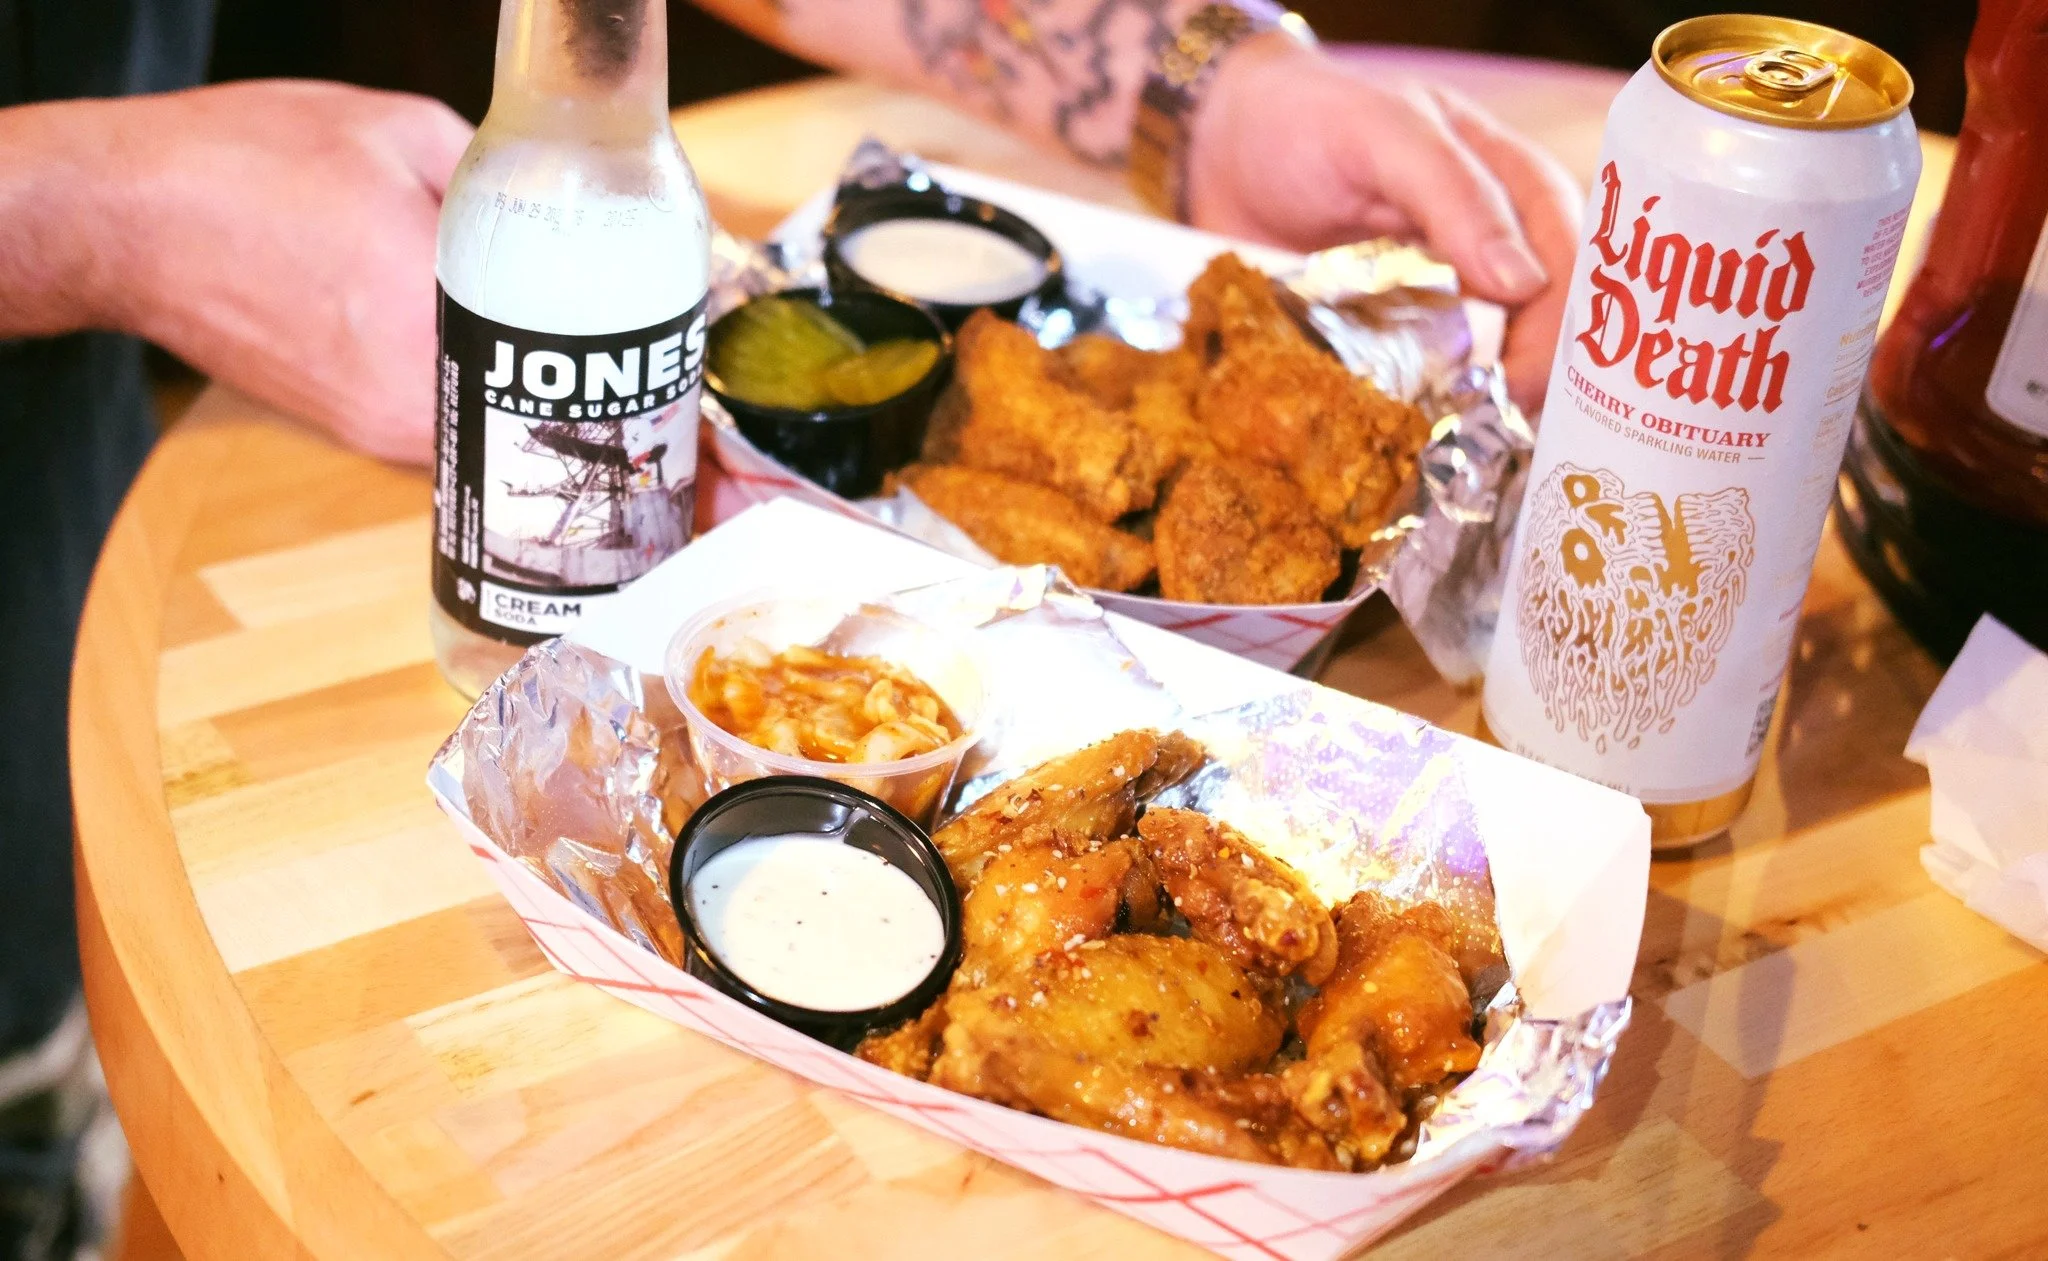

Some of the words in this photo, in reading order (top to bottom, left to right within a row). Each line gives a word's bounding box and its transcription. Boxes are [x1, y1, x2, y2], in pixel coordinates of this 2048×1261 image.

[1589, 160, 1815, 325] Liquid
[484, 315, 706, 401] JONES
[1575, 264, 1790, 414] Death
[484, 388, 553, 417] CANE
[568, 394, 655, 418] SUGAR
[1567, 365, 1636, 421] CHERRY
[1641, 412, 1771, 448] OBITUARY
[1575, 398, 1622, 434] FLAVORED
[1624, 427, 1693, 457] SPARKLING
[1697, 448, 1741, 464] WATER
[494, 593, 582, 617] CREAM
[494, 608, 537, 625] SODA
